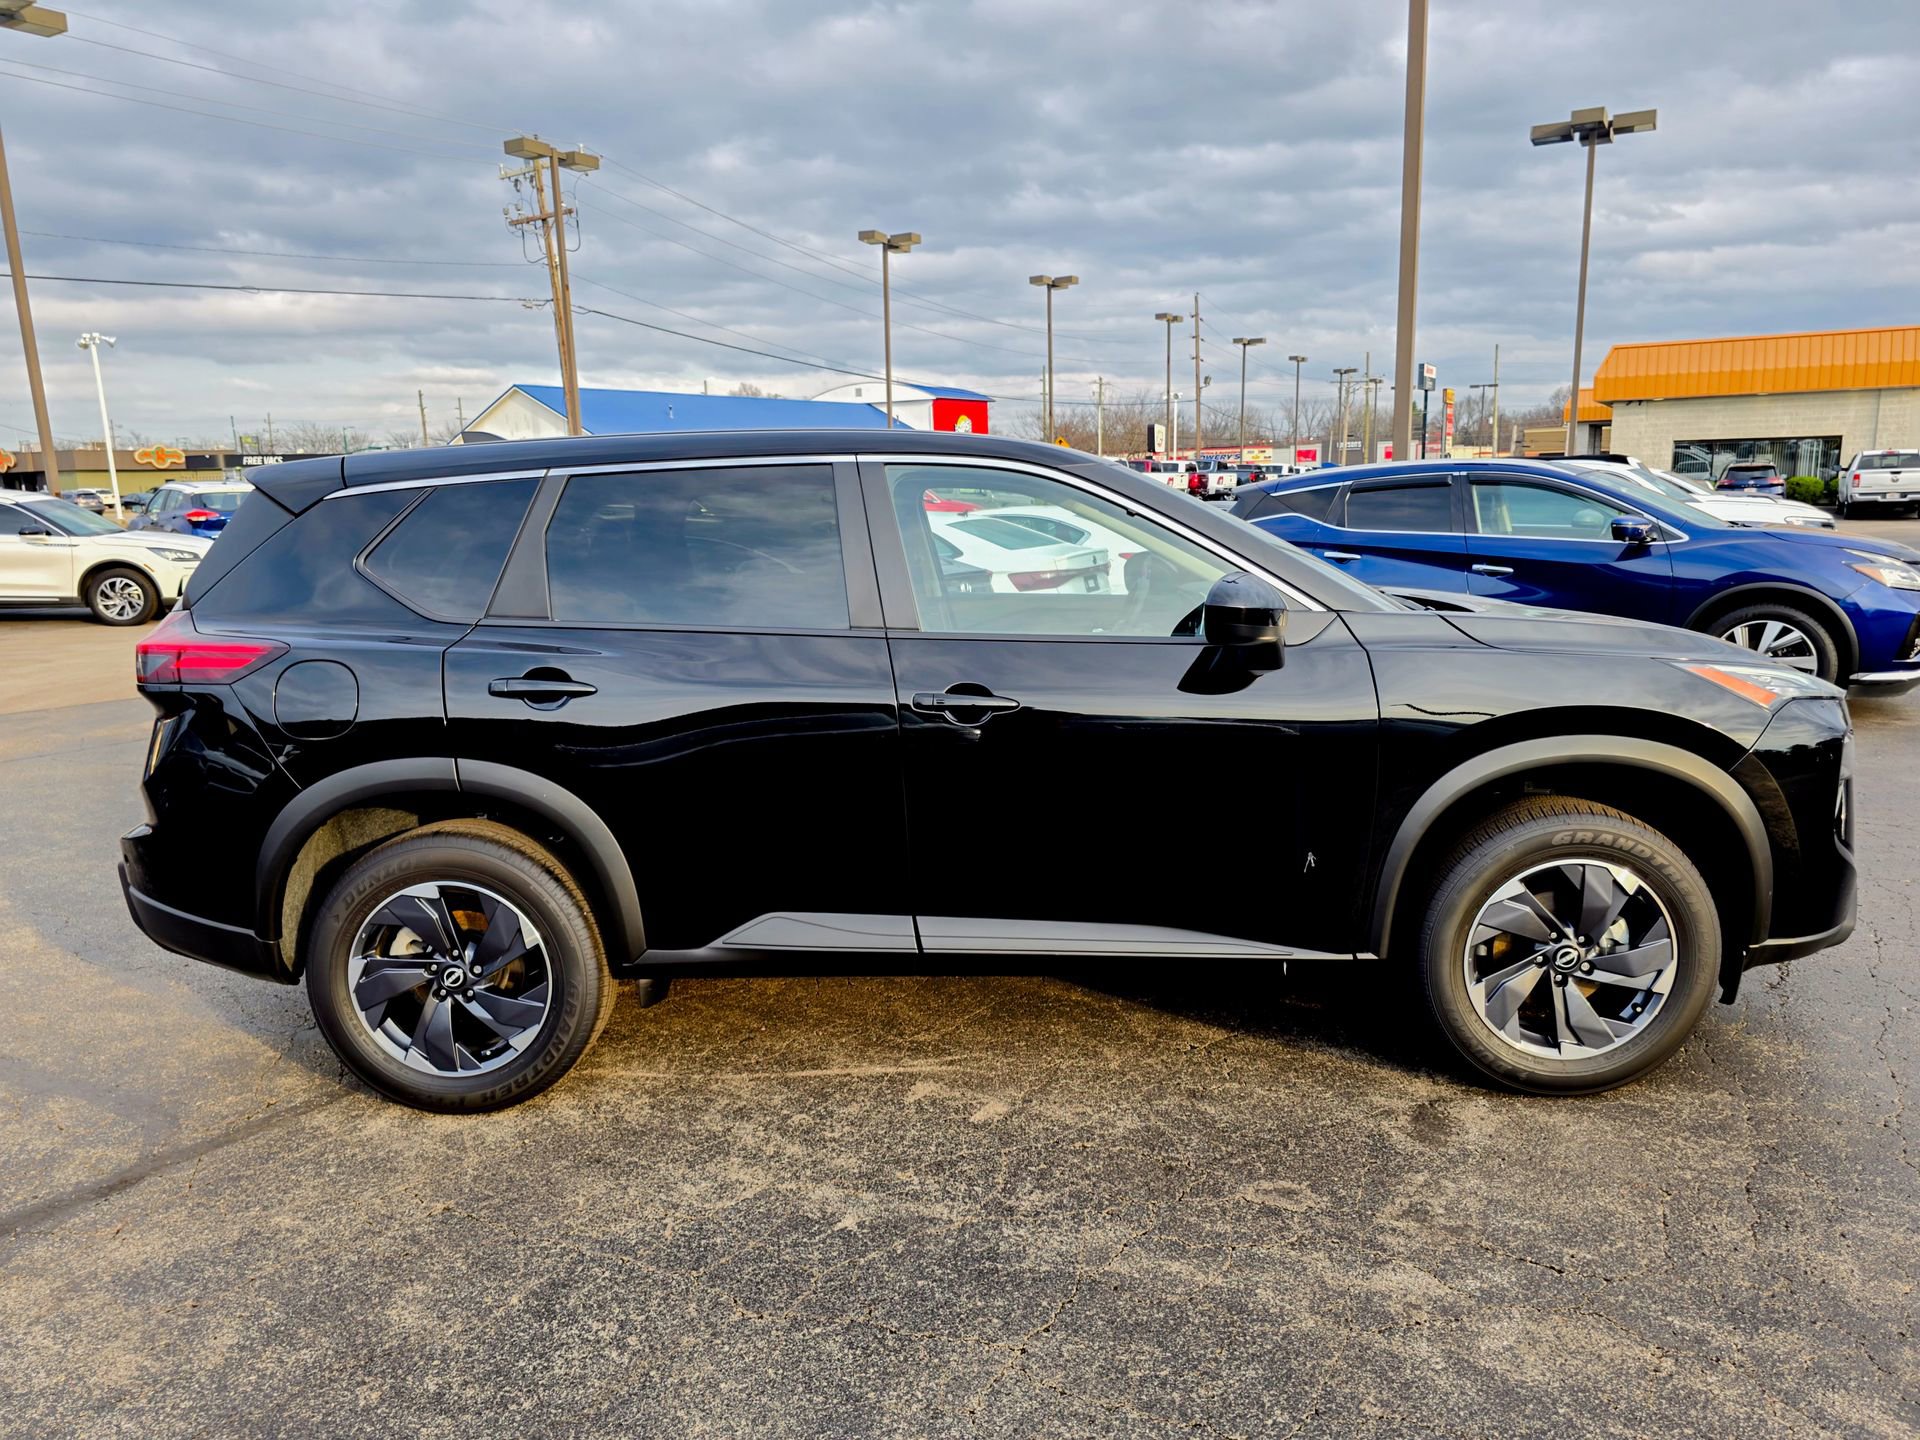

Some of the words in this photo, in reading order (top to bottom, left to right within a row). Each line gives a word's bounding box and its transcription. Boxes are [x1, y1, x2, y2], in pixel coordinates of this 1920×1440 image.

[243, 456, 263, 465] FREE
[263, 456, 284, 465] VACS
[1551, 831, 1700, 912] GRANDTREK
[479, 979, 581, 1103] GRANDTREK
